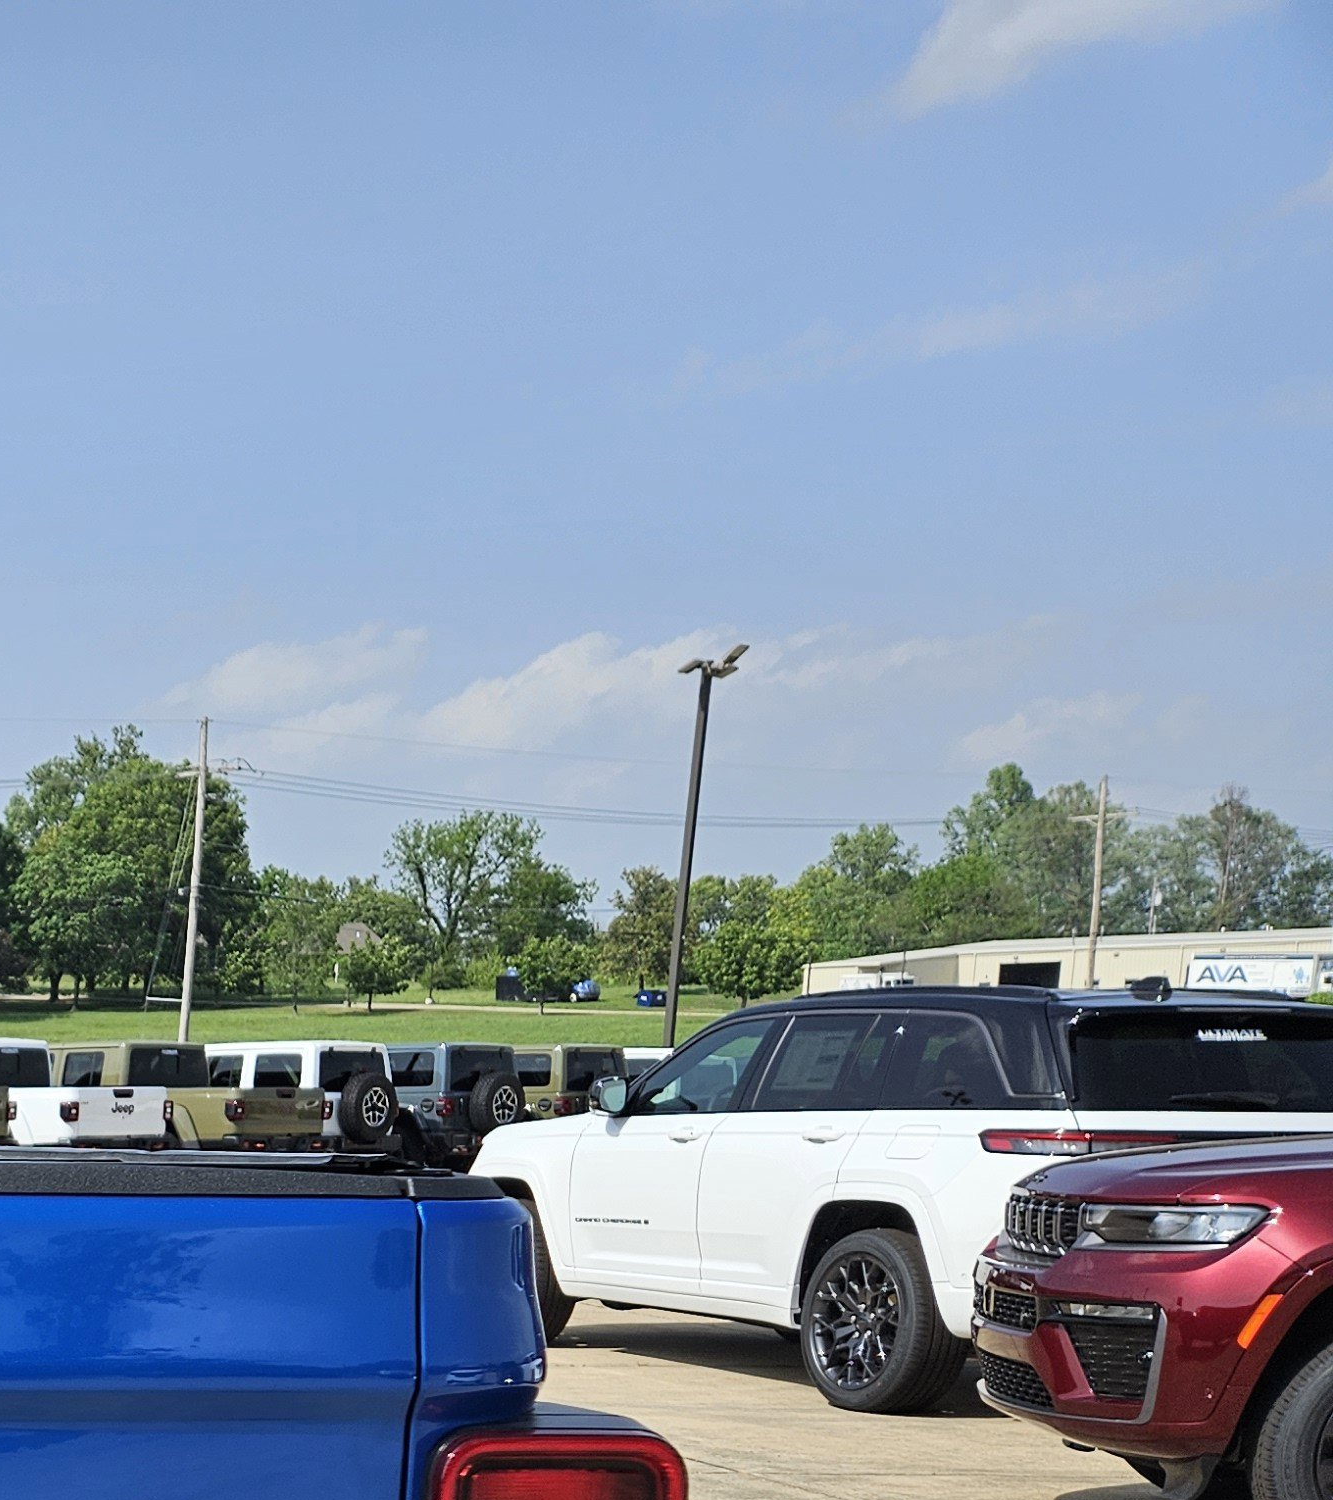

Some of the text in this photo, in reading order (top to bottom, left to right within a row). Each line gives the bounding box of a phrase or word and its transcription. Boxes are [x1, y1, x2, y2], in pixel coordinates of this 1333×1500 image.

[1196, 964, 1248, 983] AVA
[1197, 1029, 1265, 1039] ULTIMATE
[111, 1102, 135, 1115] Jeep
